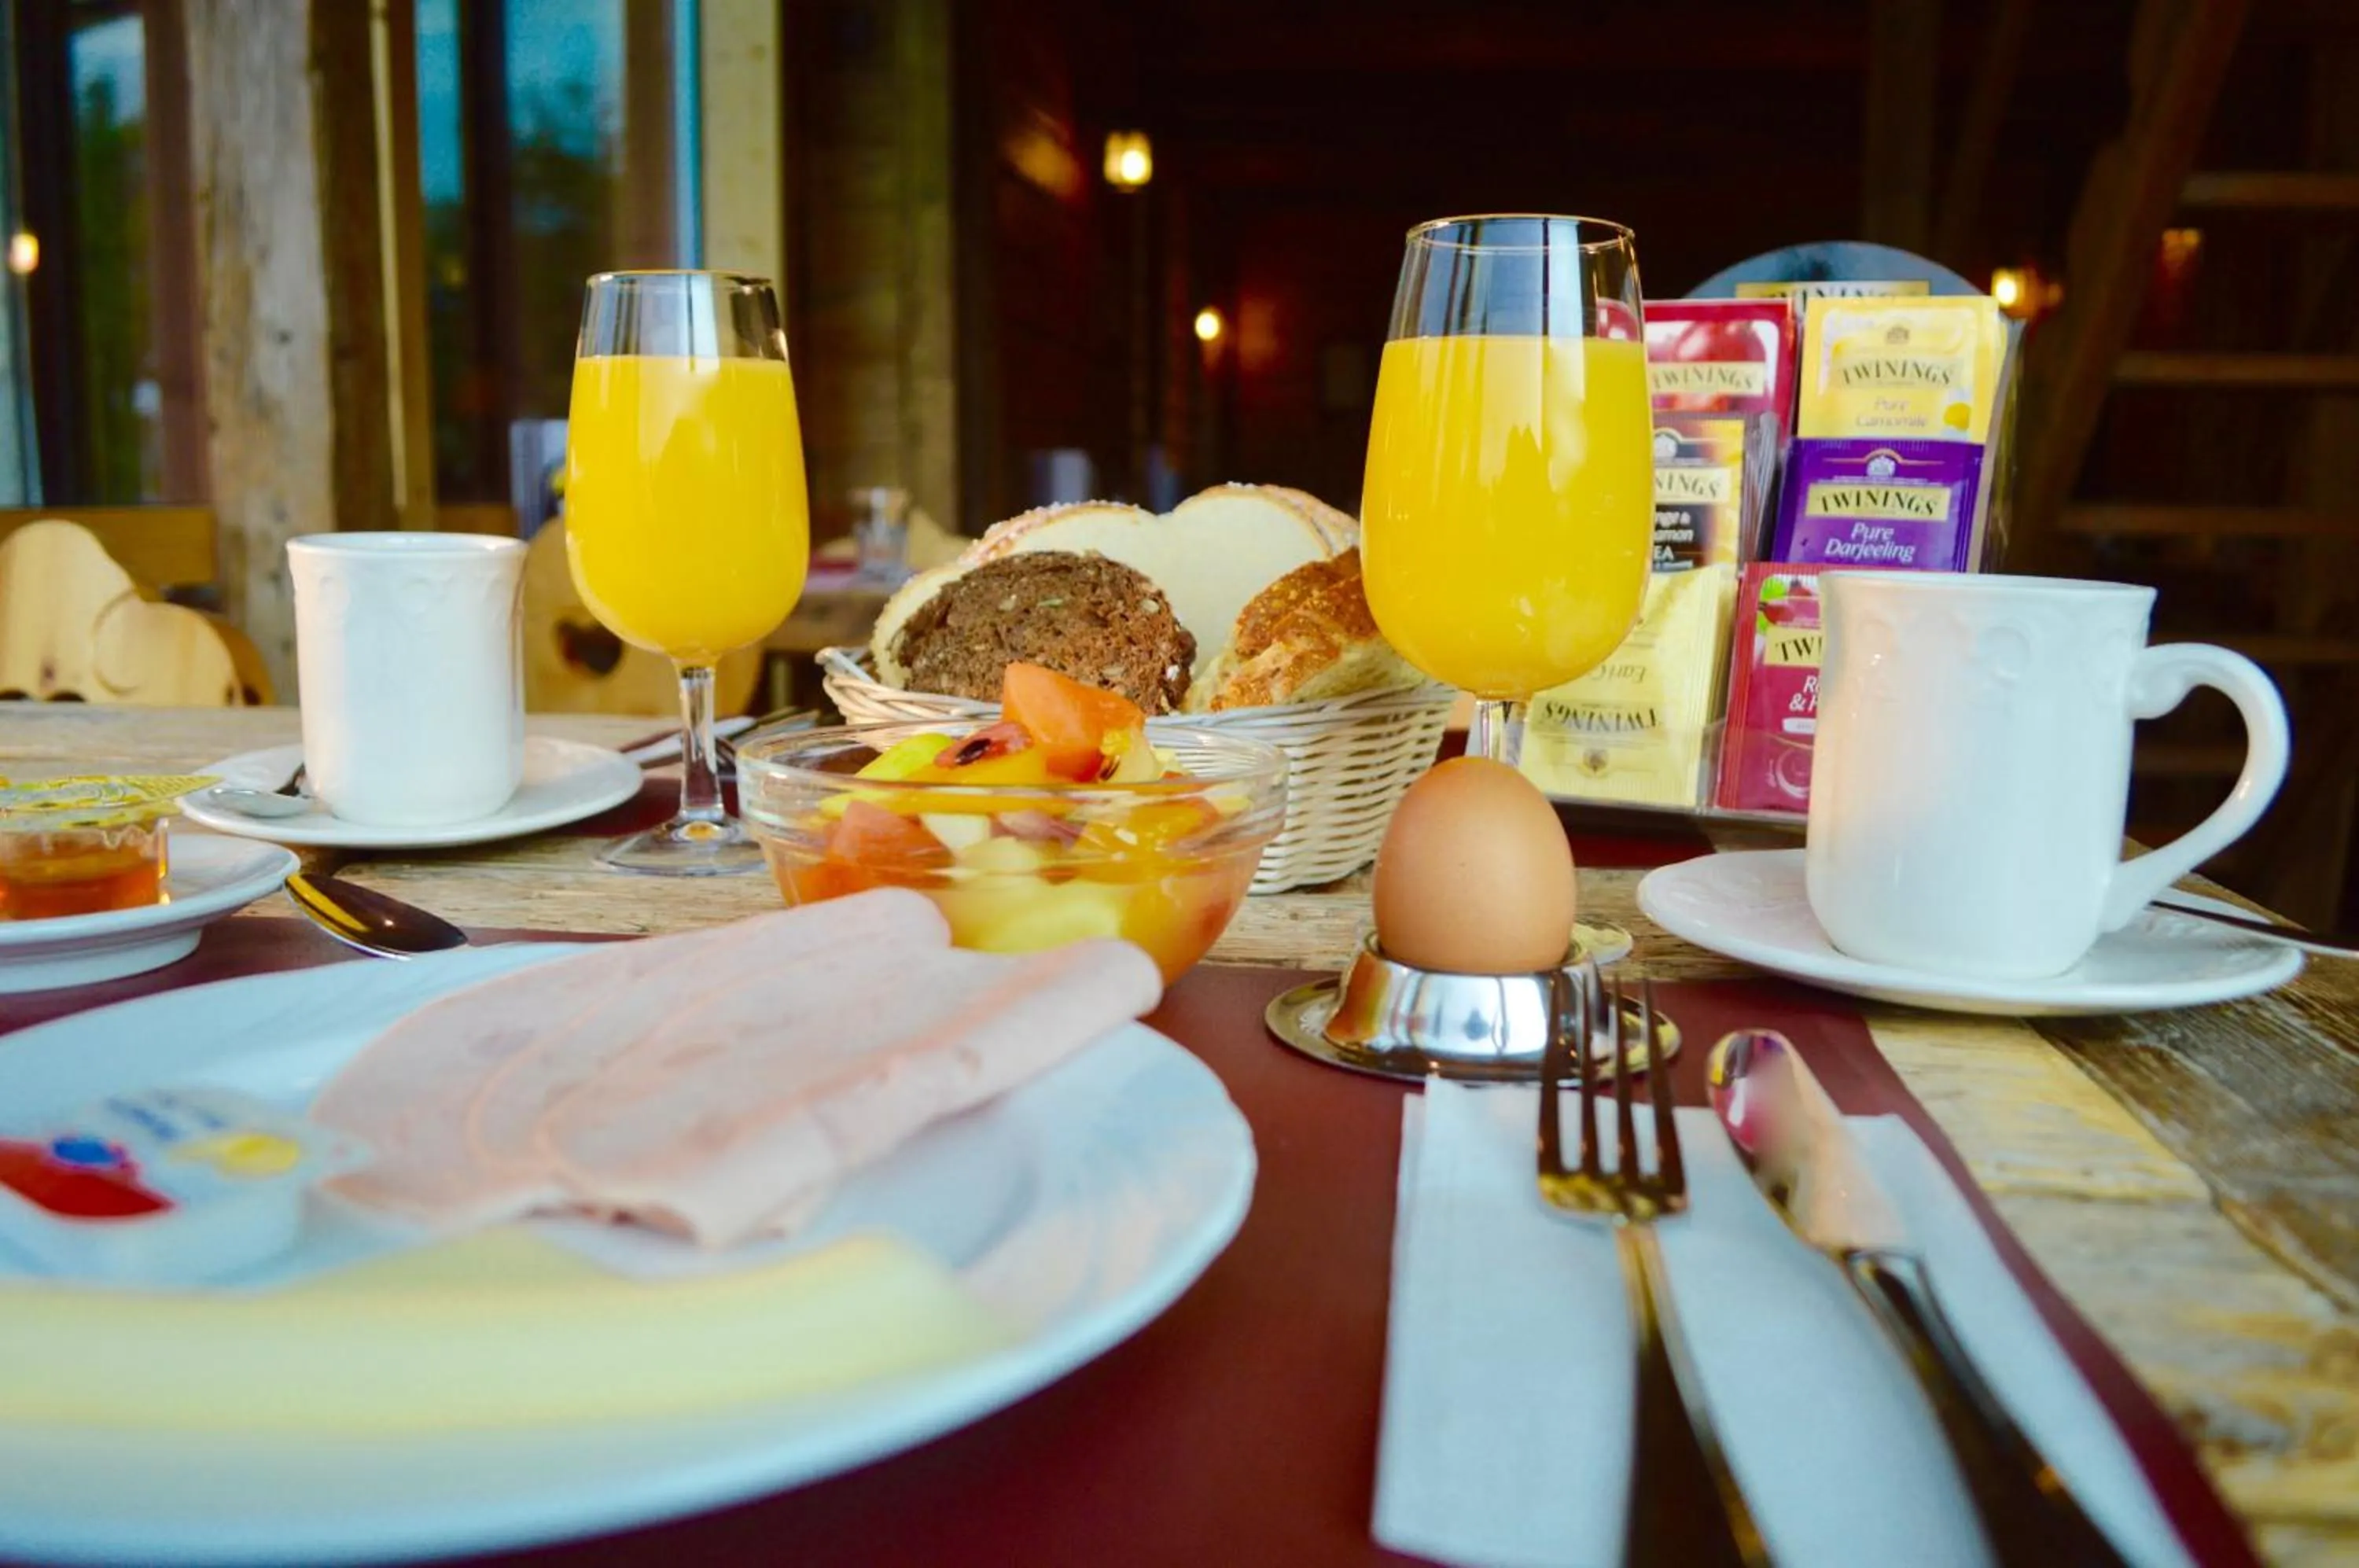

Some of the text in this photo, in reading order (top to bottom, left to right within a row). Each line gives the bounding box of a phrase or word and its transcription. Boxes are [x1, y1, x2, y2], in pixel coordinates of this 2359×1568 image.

[1651, 365, 1757, 390] TWININGS
[1838, 359, 1953, 385] TWININGS
[1817, 489, 1939, 516] TWININGS
[1850, 521, 1894, 540] Pure
[1824, 537, 1916, 564] Darjeeling
[1540, 700, 1662, 731] TWININGS
